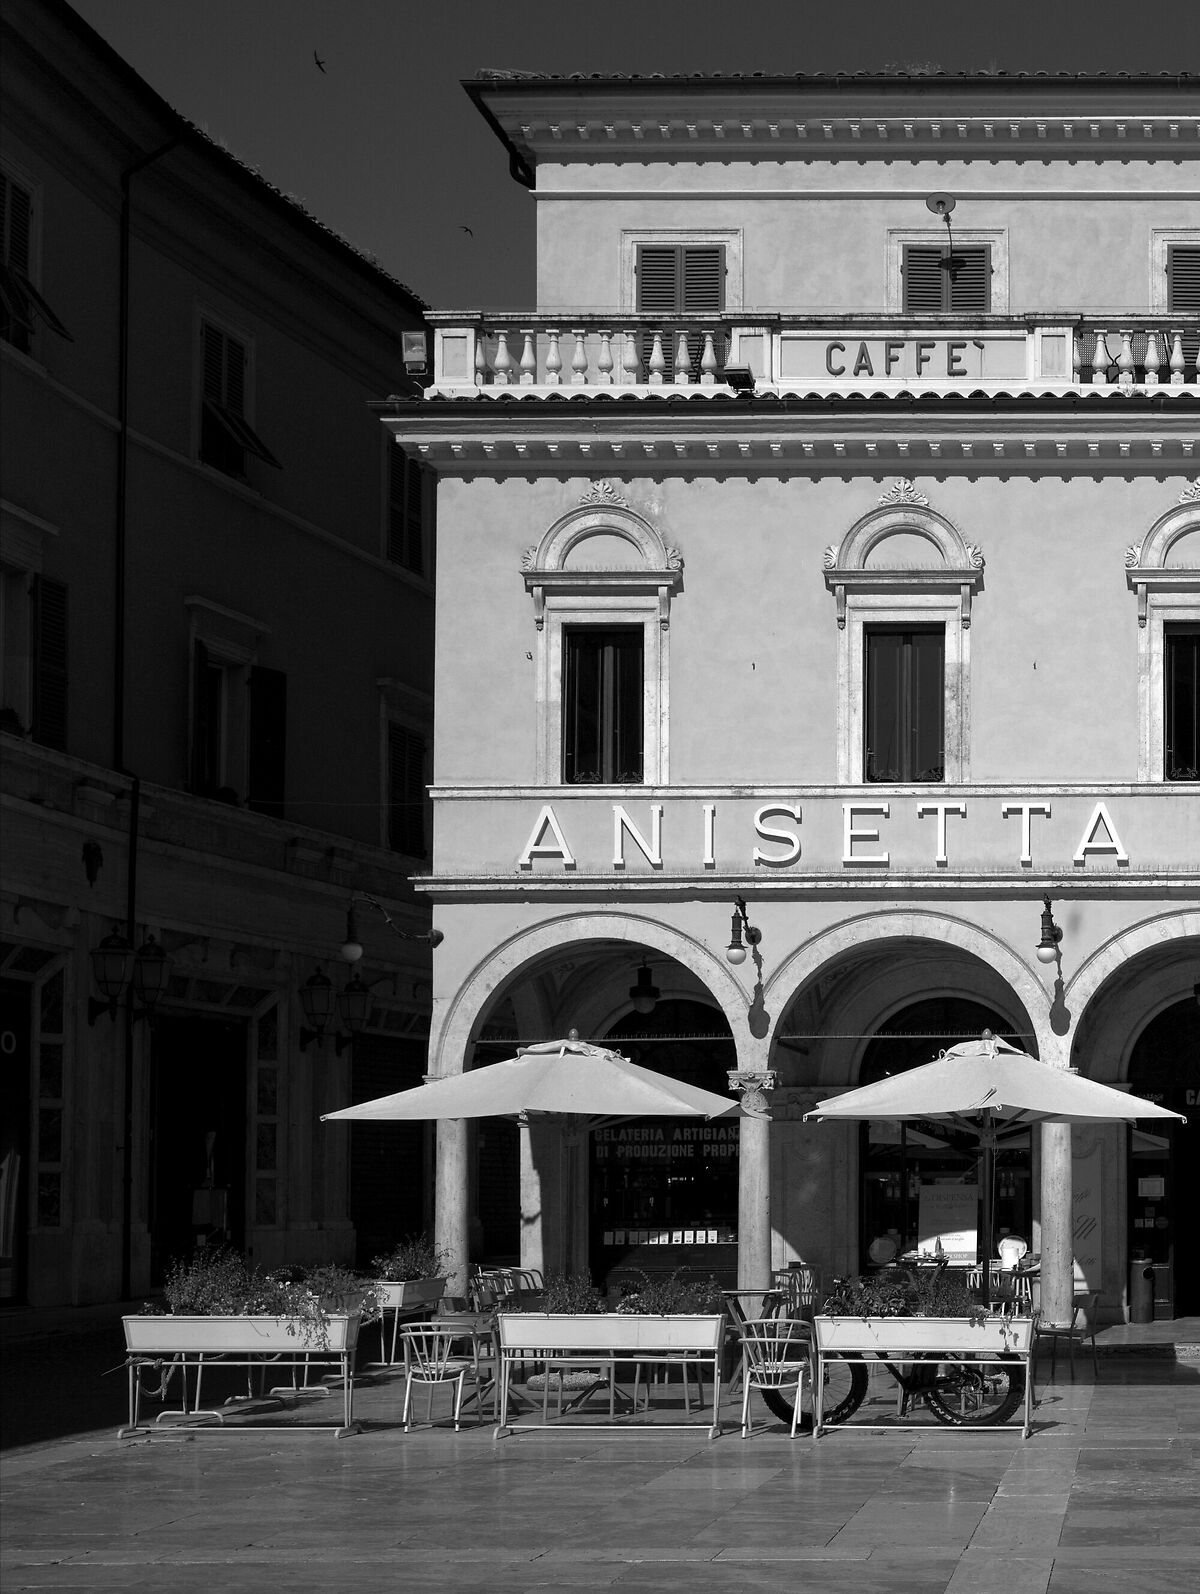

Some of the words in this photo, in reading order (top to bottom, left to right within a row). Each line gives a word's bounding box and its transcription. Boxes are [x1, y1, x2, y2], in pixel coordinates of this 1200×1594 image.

[517, 801, 1130, 871] ANISETTA
[594, 1128, 665, 1142] GELATERIA
[672, 1127, 740, 1142] ARTIGIAN
[595, 1145, 610, 1158] DI
[616, 1144, 695, 1158] PRODUZIONE
